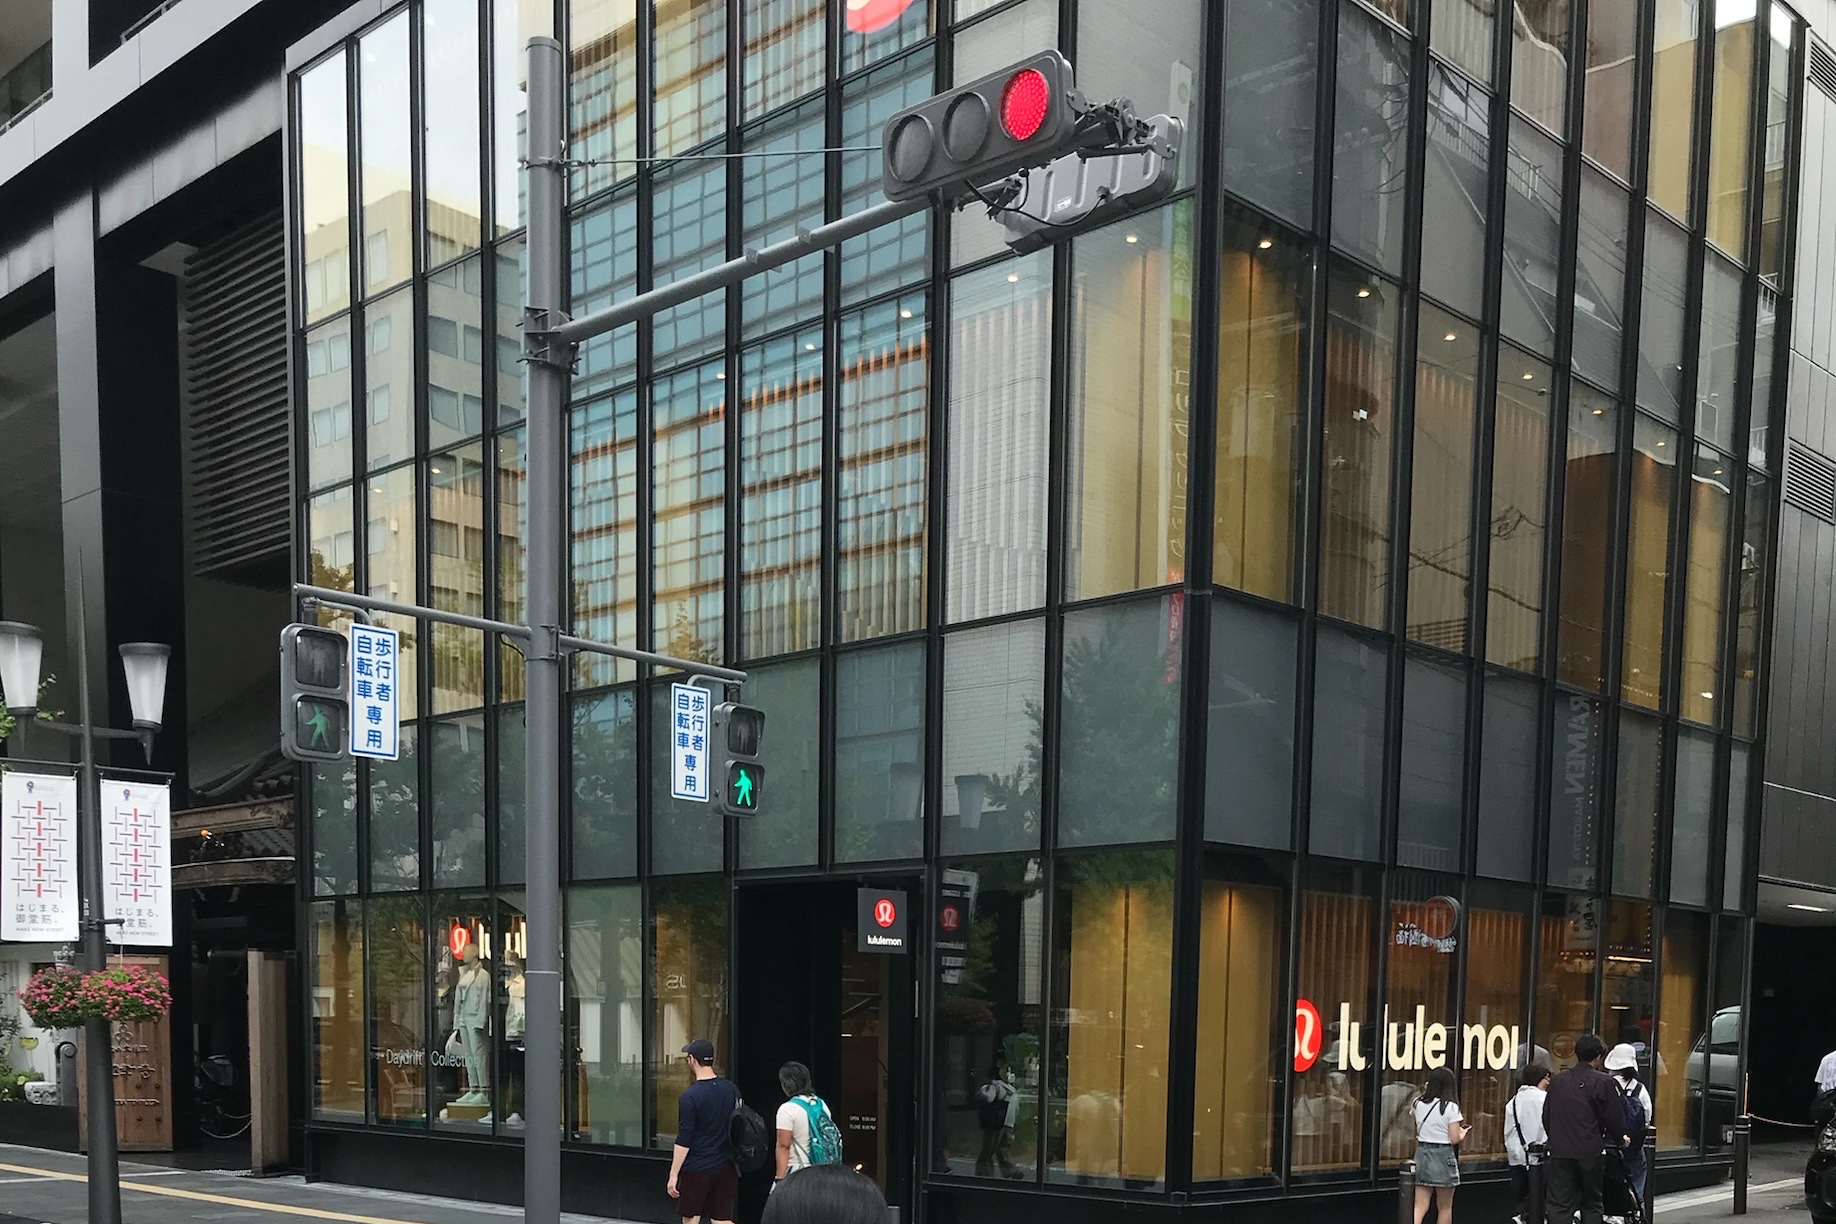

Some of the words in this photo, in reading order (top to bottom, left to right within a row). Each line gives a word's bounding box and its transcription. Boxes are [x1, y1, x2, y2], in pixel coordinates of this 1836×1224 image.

[356, 635, 373, 699] 自転車
[375, 638, 392, 702] 歩行者
[366, 705, 382, 749] 専用
[677, 693, 690, 749] 自転車
[691, 695, 705, 751] 歩行者
[684, 754, 697, 792] 専用
[867, 935, 902, 946] lululemon
